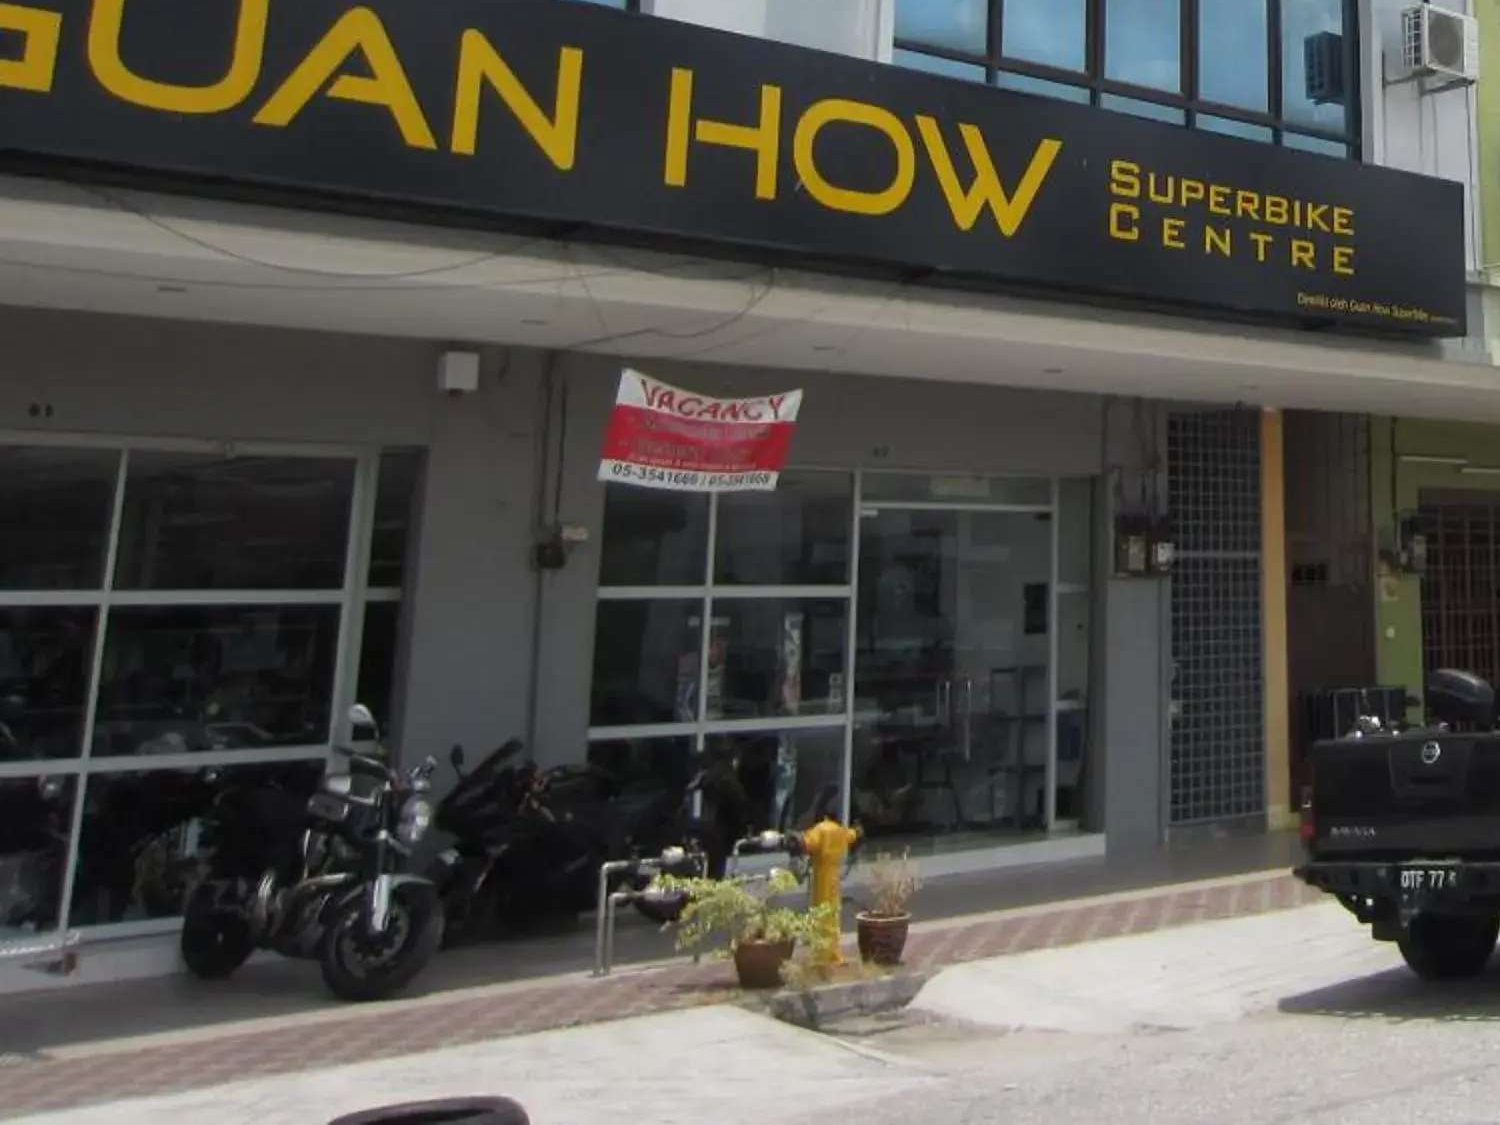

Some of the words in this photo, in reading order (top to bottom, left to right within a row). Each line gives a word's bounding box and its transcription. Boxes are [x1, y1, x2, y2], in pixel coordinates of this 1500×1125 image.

[664, 68, 1063, 237] HOW
[1110, 159, 1355, 236] SUPERBIKE
[1109, 202, 1355, 275] CENTRE
[641, 378, 786, 421] VACANCY
